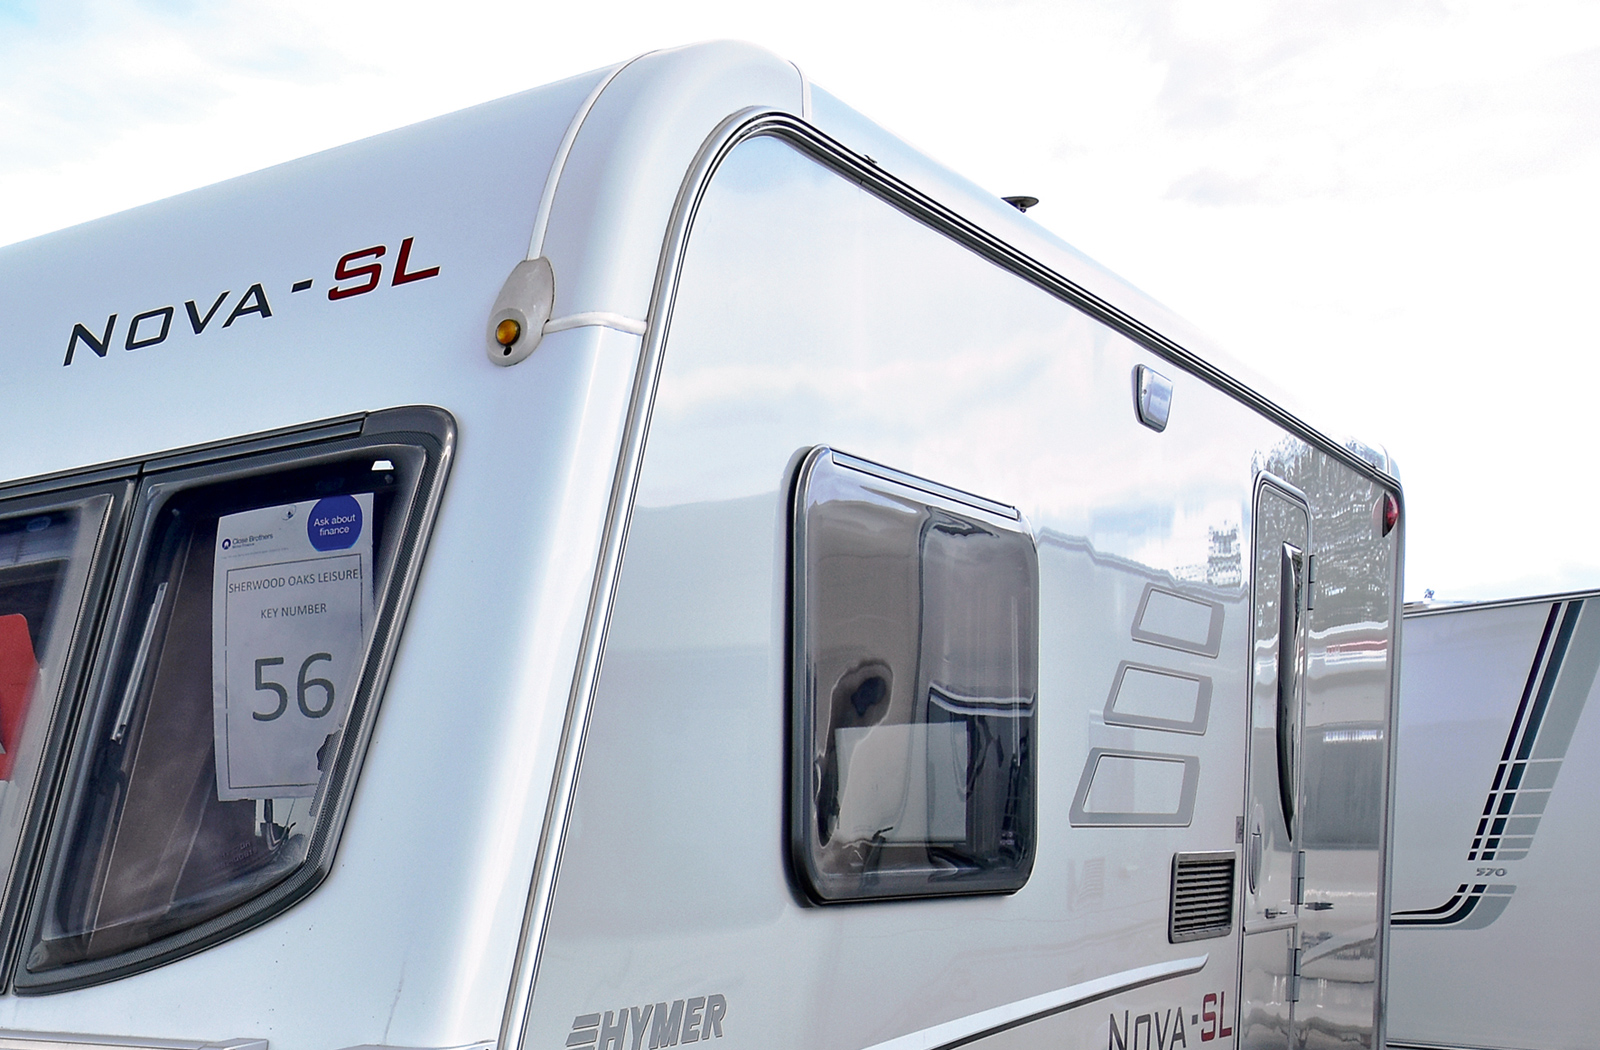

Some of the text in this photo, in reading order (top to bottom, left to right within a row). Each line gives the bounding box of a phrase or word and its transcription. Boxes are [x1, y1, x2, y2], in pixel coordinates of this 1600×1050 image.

[313, 513, 356, 527] Ask about
[319, 526, 350, 537] finance
[228, 568, 359, 594] SHERWOOD OAKS LEISURE
[260, 602, 327, 620] KEY NUMBER
[252, 652, 335, 722] 56
[1476, 867, 1508, 877] 570
